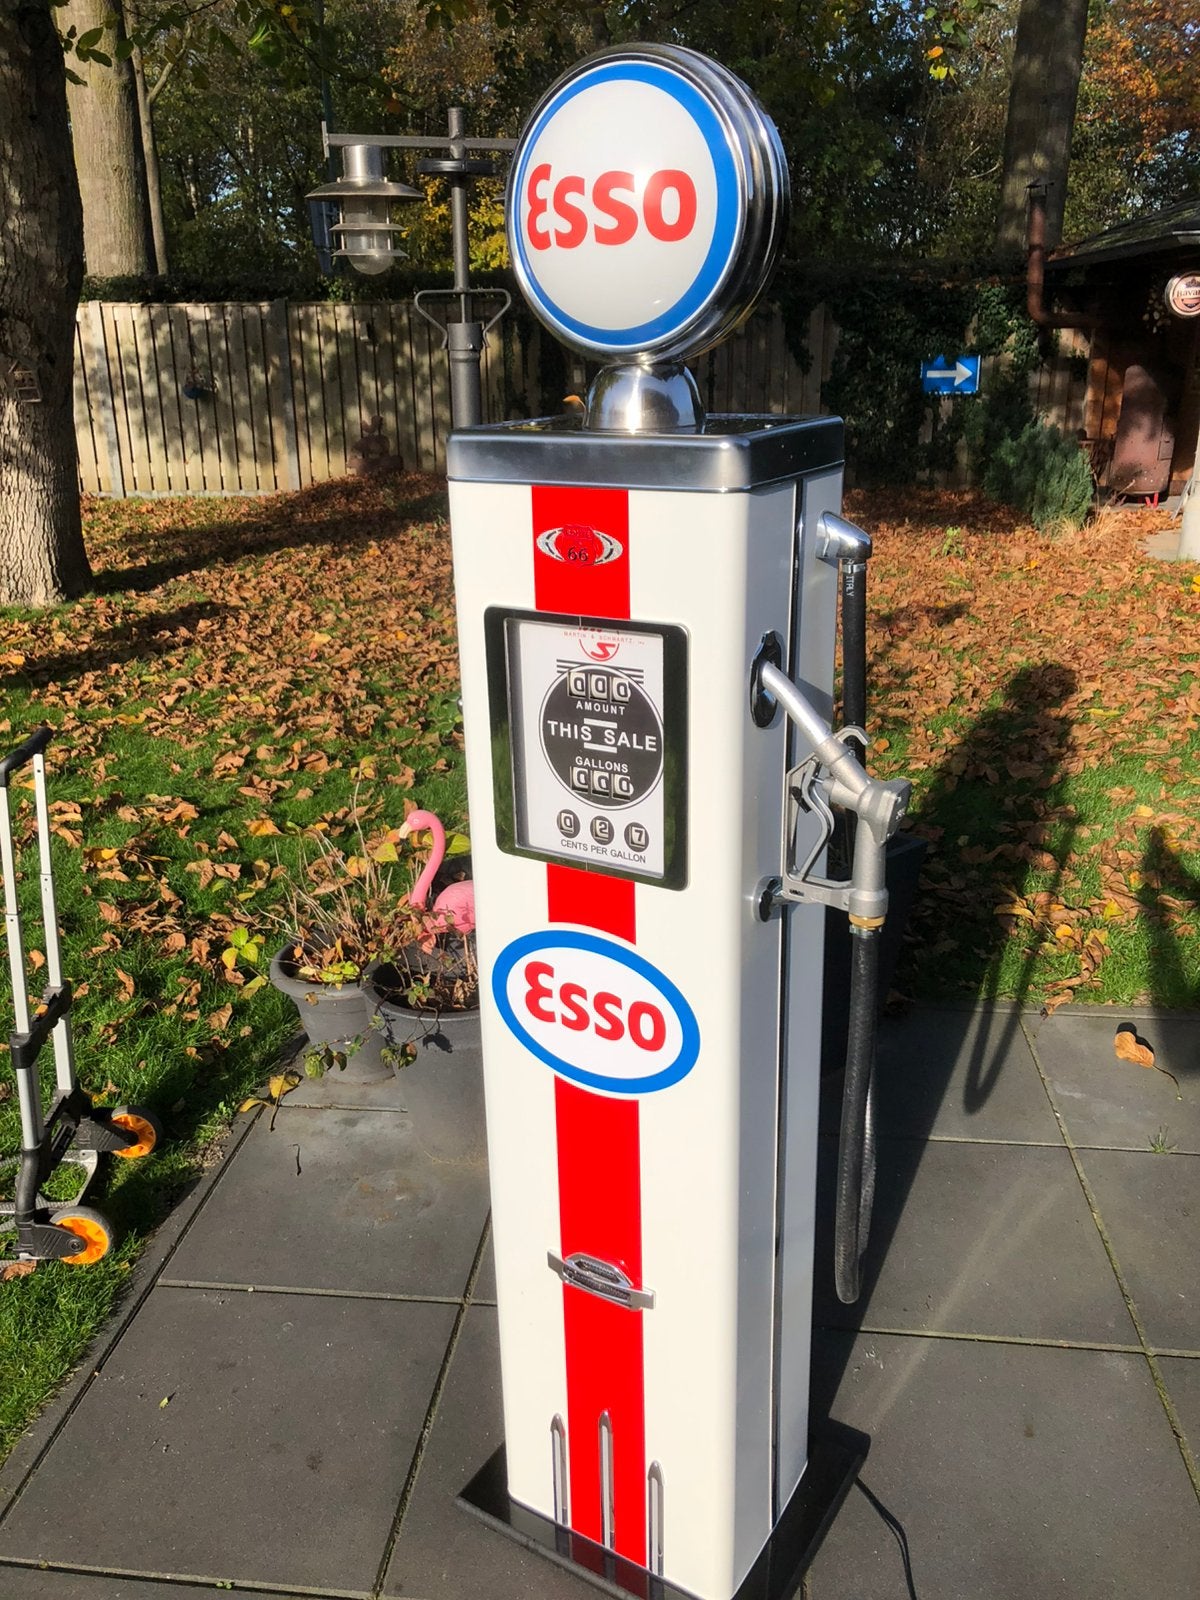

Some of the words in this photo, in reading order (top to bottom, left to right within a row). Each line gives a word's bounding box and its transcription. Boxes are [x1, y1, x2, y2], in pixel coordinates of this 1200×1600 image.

[567, 547, 589, 562] 66
[845, 575, 855, 597] ITALY
[575, 700, 626, 716] AMOUNT
[547, 720, 593, 742] THIS
[604, 729, 657, 752] SALE
[575, 756, 629, 774] GALLONS
[560, 838, 589, 852] CENTS
[590, 844, 608, 856] PER
[610, 848, 646, 864] GALLON
